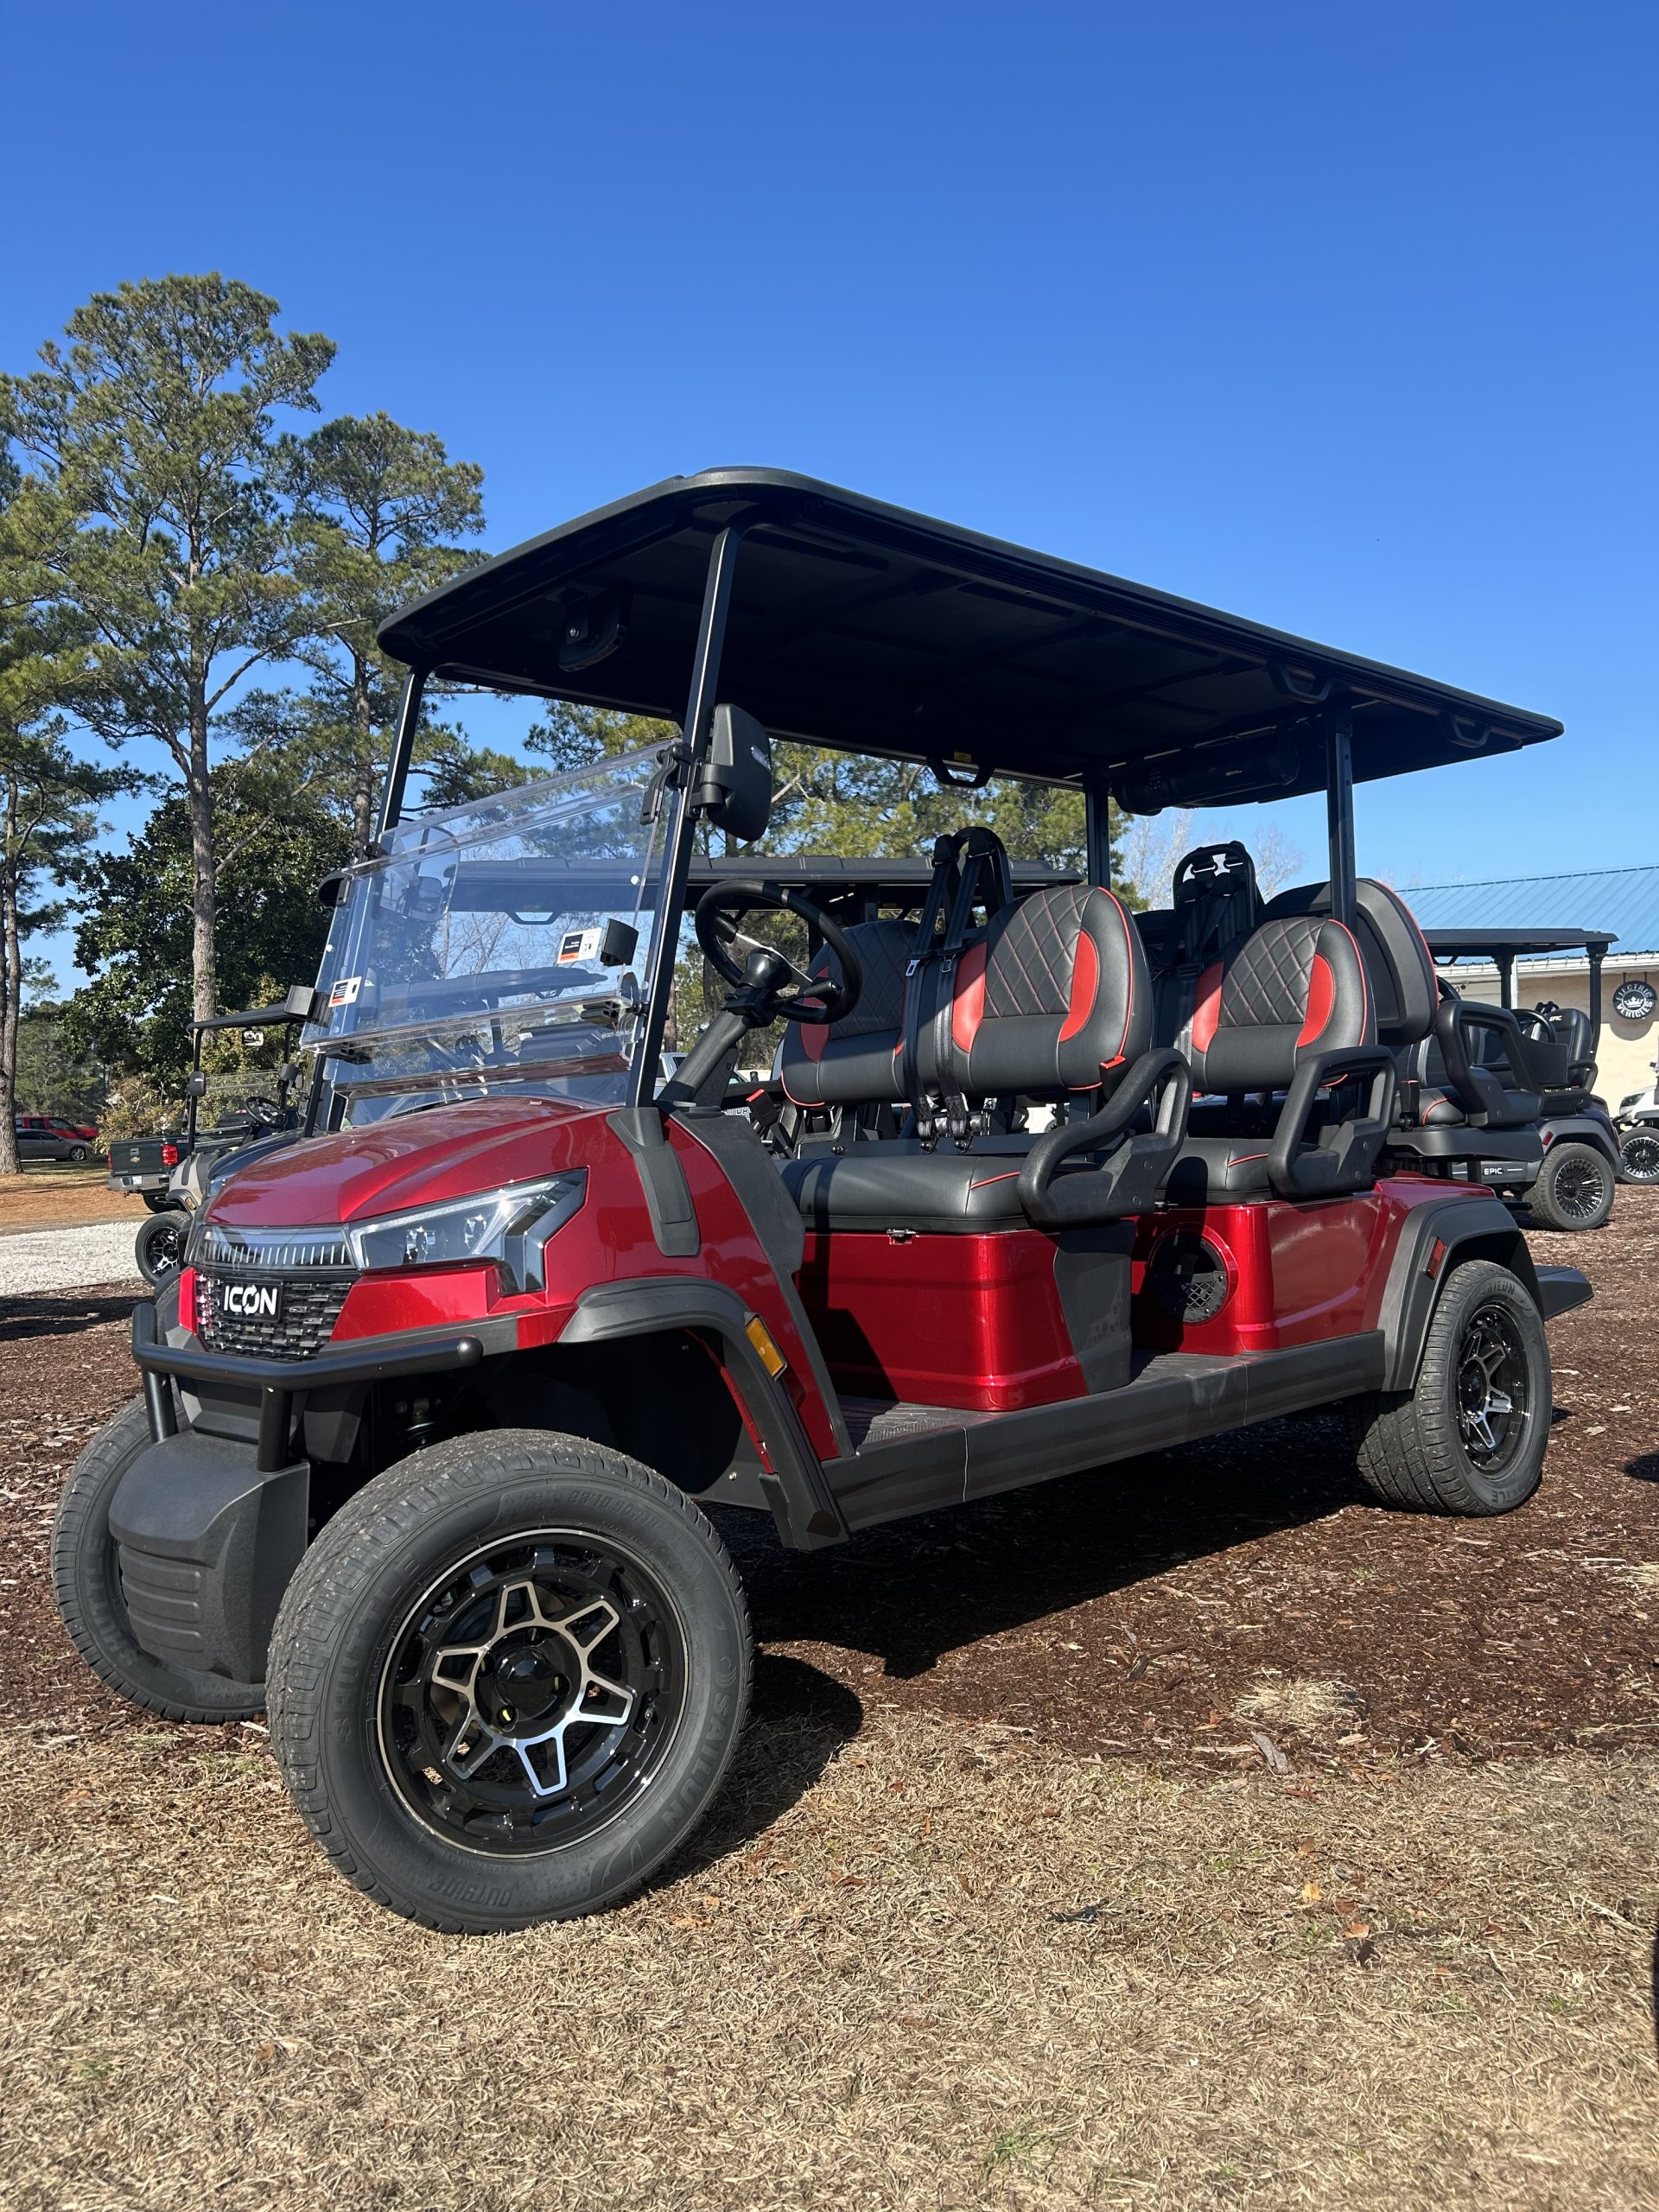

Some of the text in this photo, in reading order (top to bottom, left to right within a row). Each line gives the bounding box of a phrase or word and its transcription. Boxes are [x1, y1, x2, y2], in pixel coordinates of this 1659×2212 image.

[1617, 1001, 1653, 1018] VEHICLES
[224, 1284, 277, 1315] ICON
[331, 1553, 422, 1743] SHUTTLE
[661, 1693, 732, 1833] SAILUN
